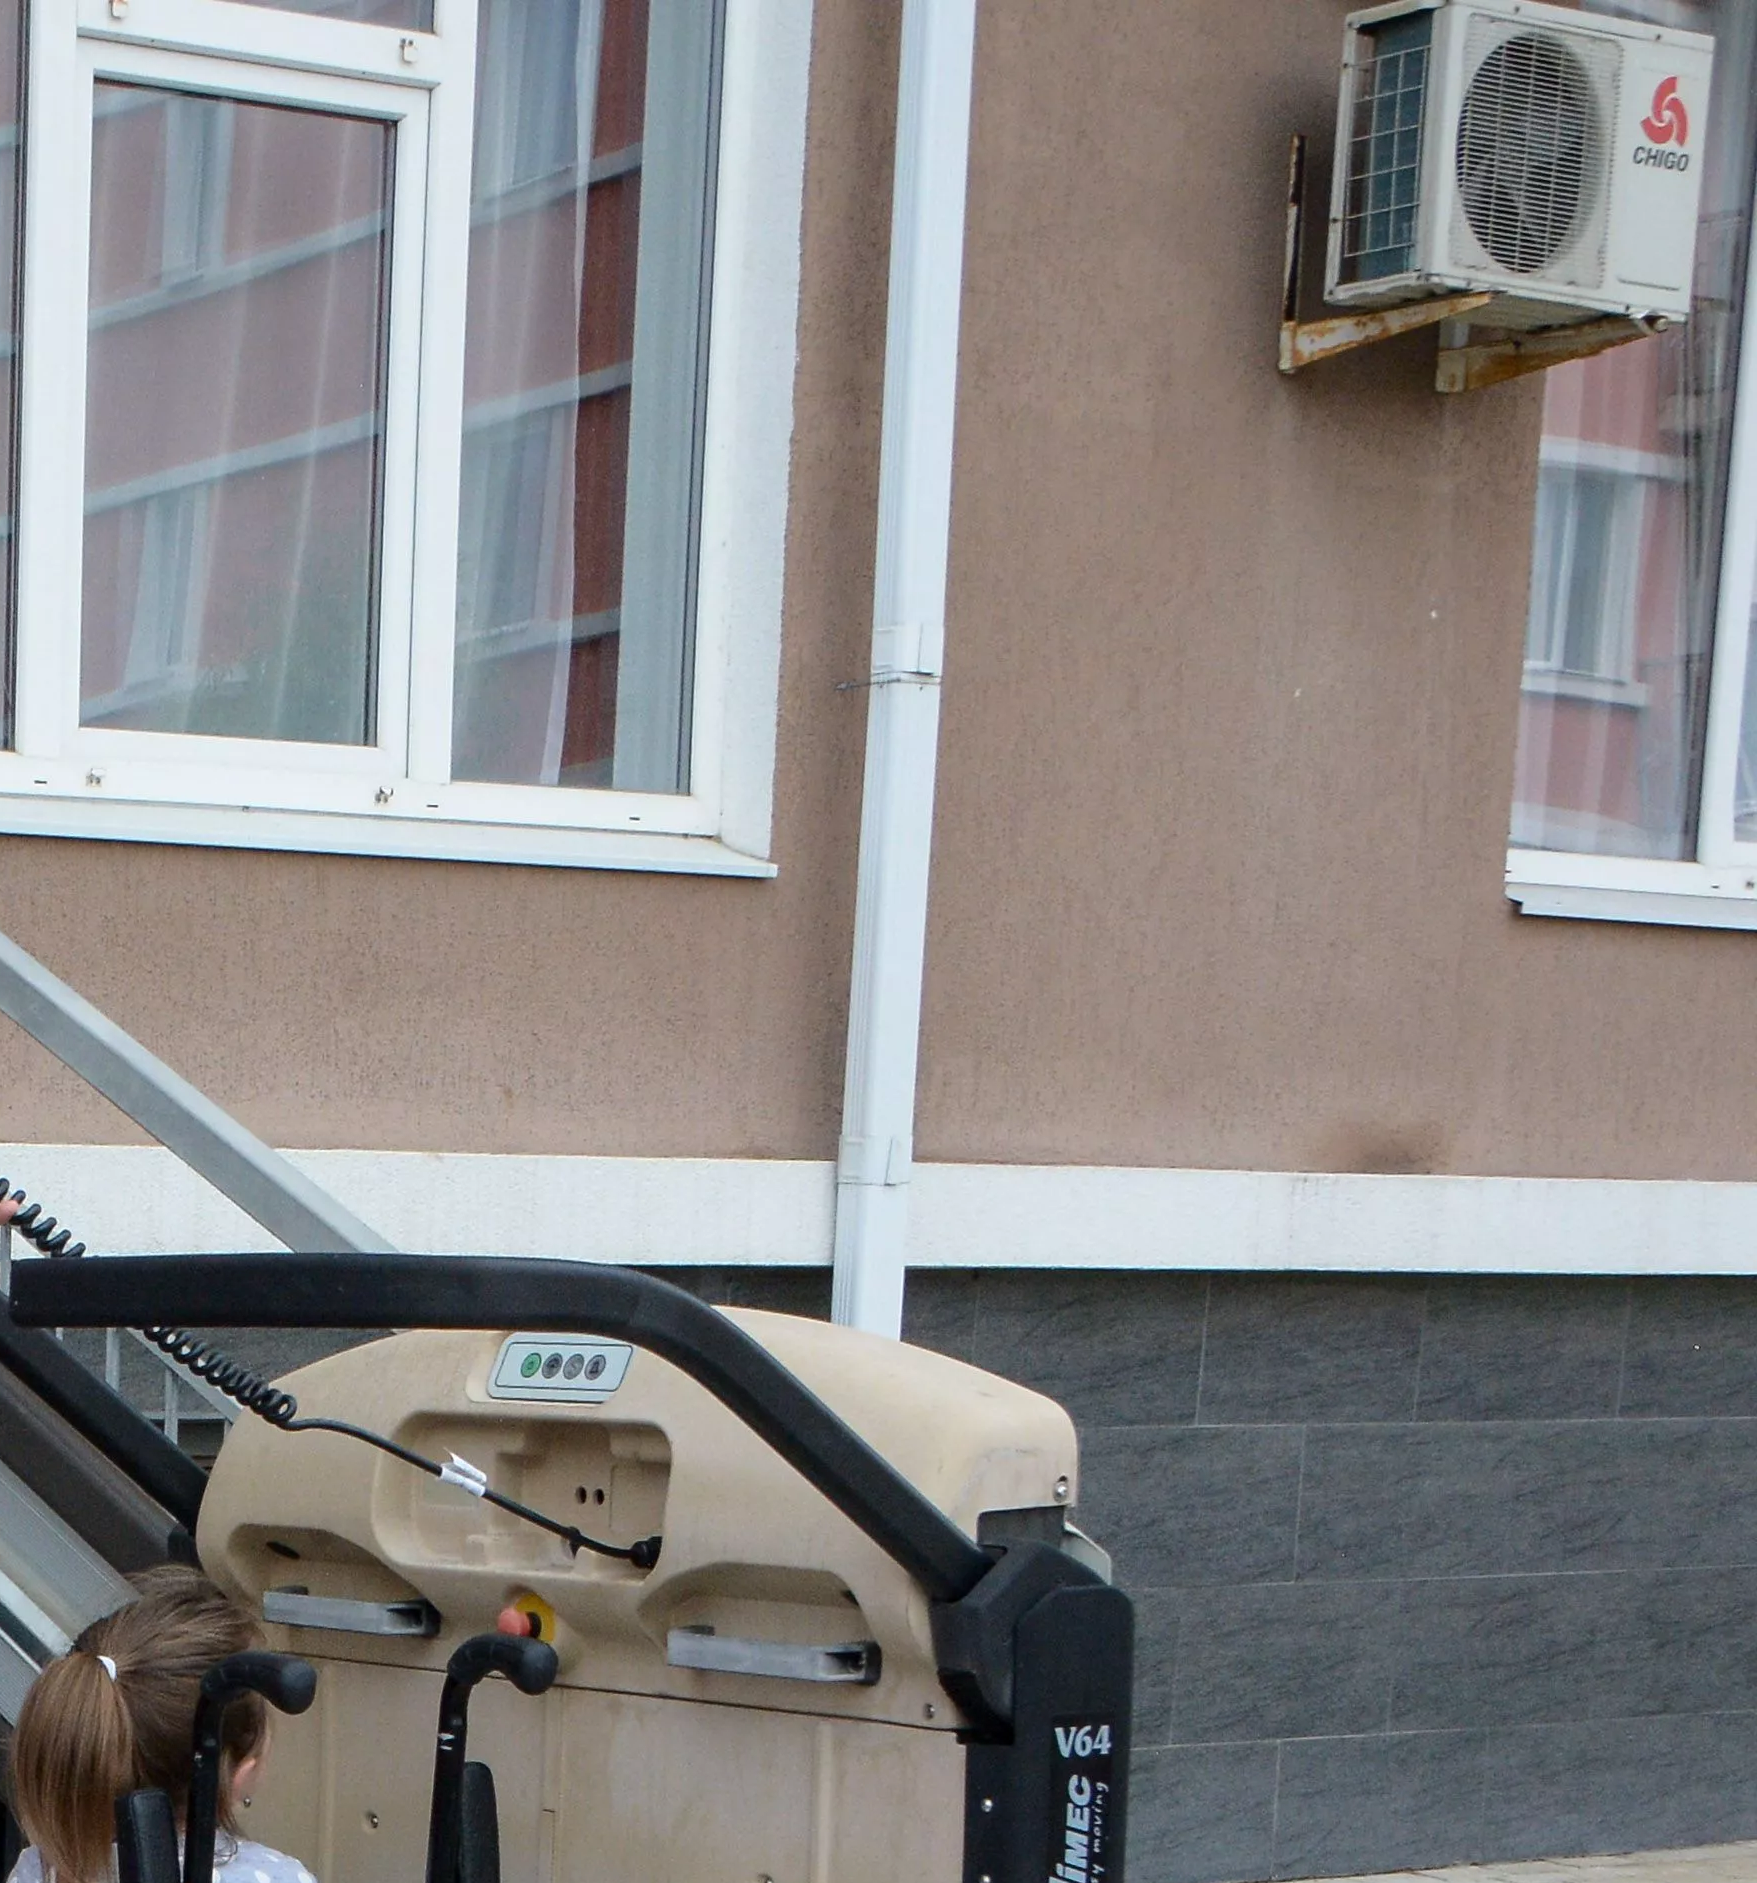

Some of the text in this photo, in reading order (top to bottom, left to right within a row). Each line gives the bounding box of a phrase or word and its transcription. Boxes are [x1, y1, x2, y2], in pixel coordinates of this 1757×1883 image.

[1633, 145, 1689, 172] CHIGO
[1054, 1724, 1112, 1759] V64
[1092, 1780, 1110, 1853] moving
